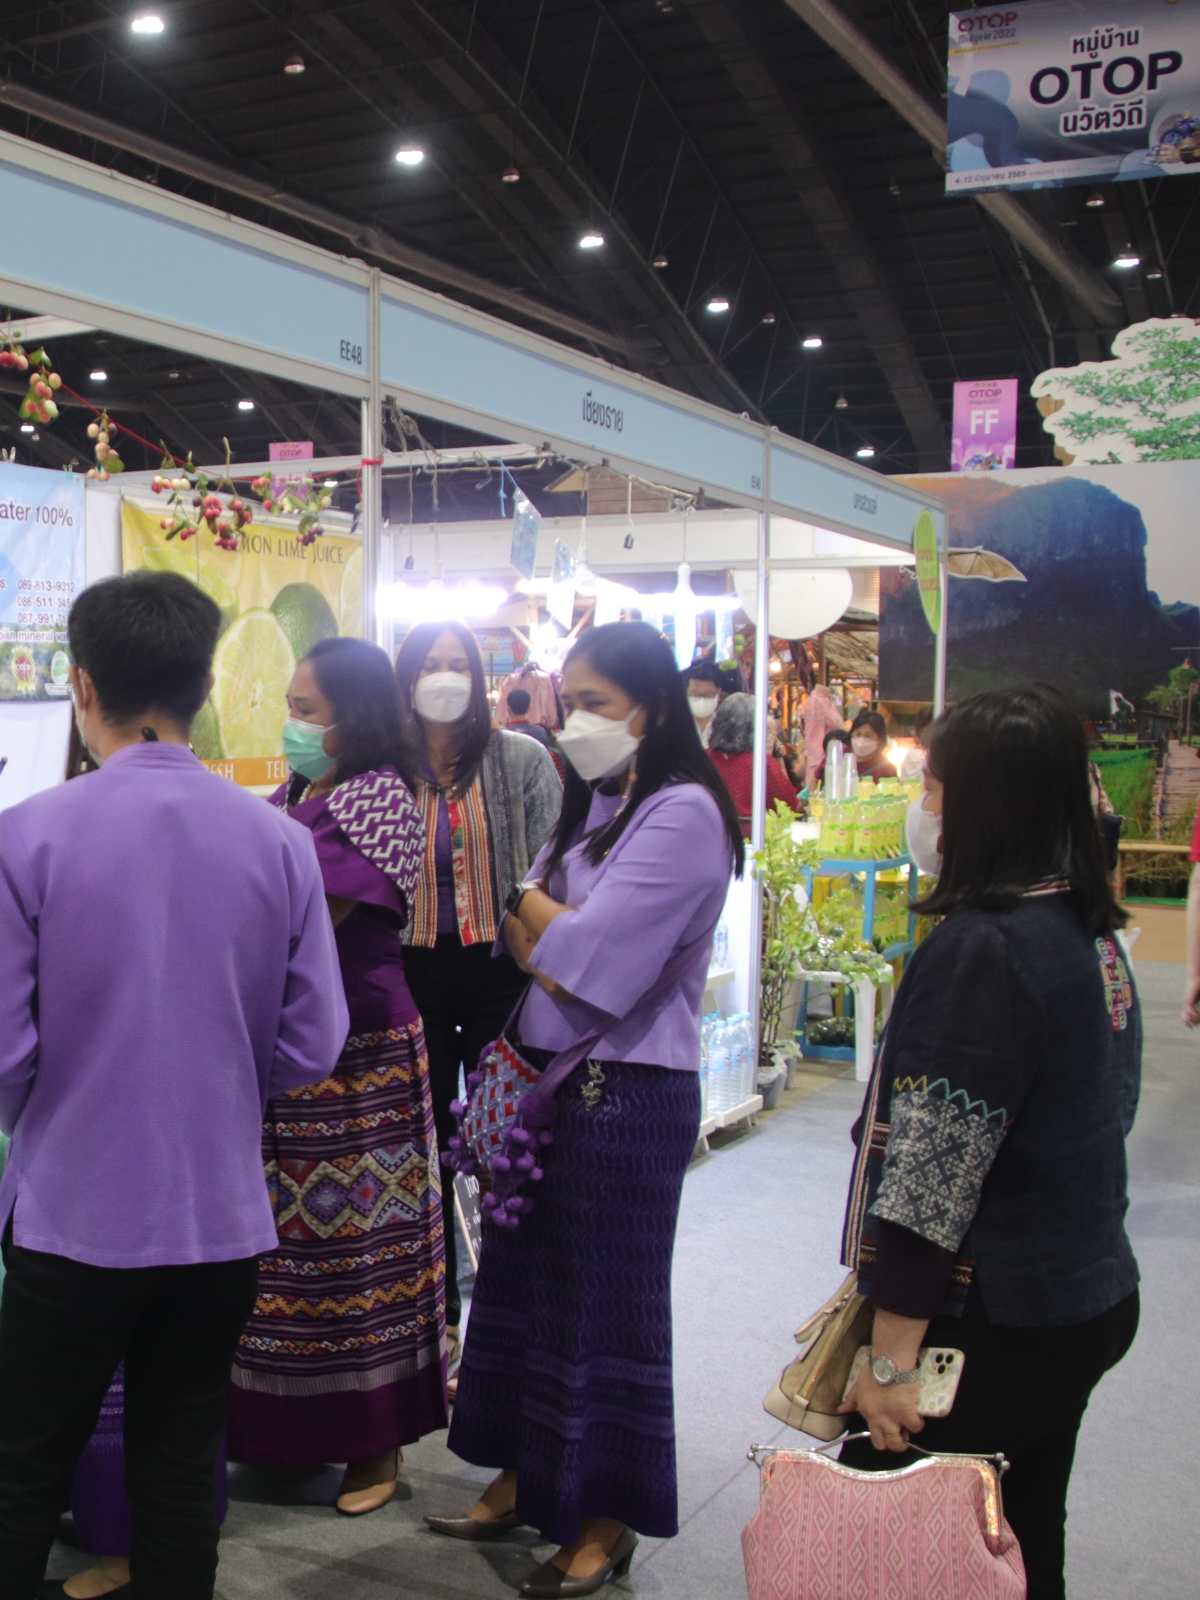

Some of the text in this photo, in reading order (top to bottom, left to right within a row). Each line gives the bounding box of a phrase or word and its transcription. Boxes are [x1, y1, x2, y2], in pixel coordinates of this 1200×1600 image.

[958, 11, 1017, 33] OTOP
[1072, 28, 1140, 59] หมู่บ้าน
[1030, 50, 1182, 105] OTOP
[1062, 99, 1143, 133] นวัตวิถี
[341, 339, 362, 365] EE48
[969, 389, 1002, 398] OTOP
[582, 391, 623, 433] เชียงราย
[970, 410, 999, 435] FF
[35, 505, 73, 527] 100%
[278, 538, 307, 559] LIME
[312, 541, 343, 564] JUICE
[18, 629, 54, 642] mineral
